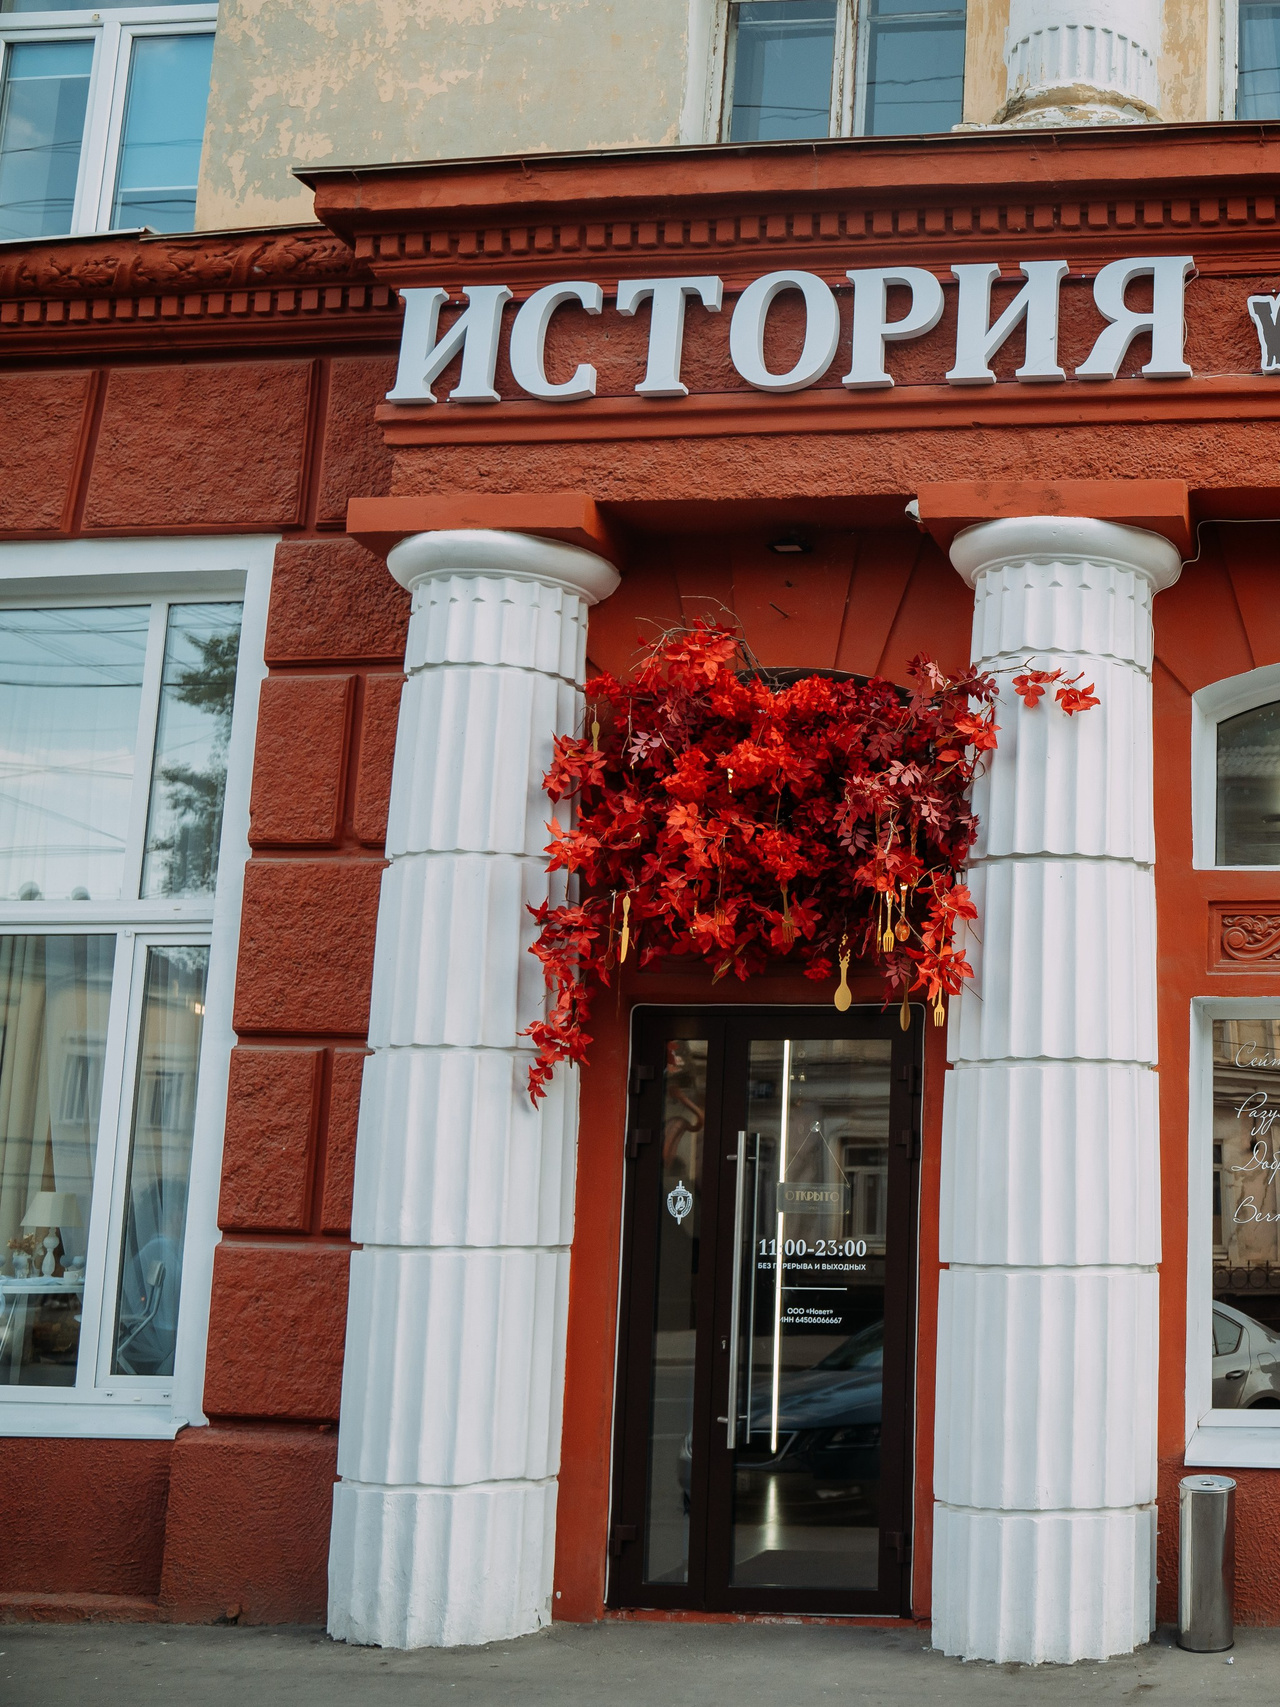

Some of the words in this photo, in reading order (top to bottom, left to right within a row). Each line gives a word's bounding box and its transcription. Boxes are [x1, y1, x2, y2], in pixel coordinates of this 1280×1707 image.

[385, 255, 1196, 404] ИСТОРИЯ
[785, 1190, 840, 1202] ОТКРЫТО
[759, 1239, 867, 1257] 11:00-23:00
[772, 1262, 813, 1270] ПРЕРЫВА
[821, 1263, 867, 1271] ВЫХОДНЫХ
[787, 1307, 805, 1315] ООО
